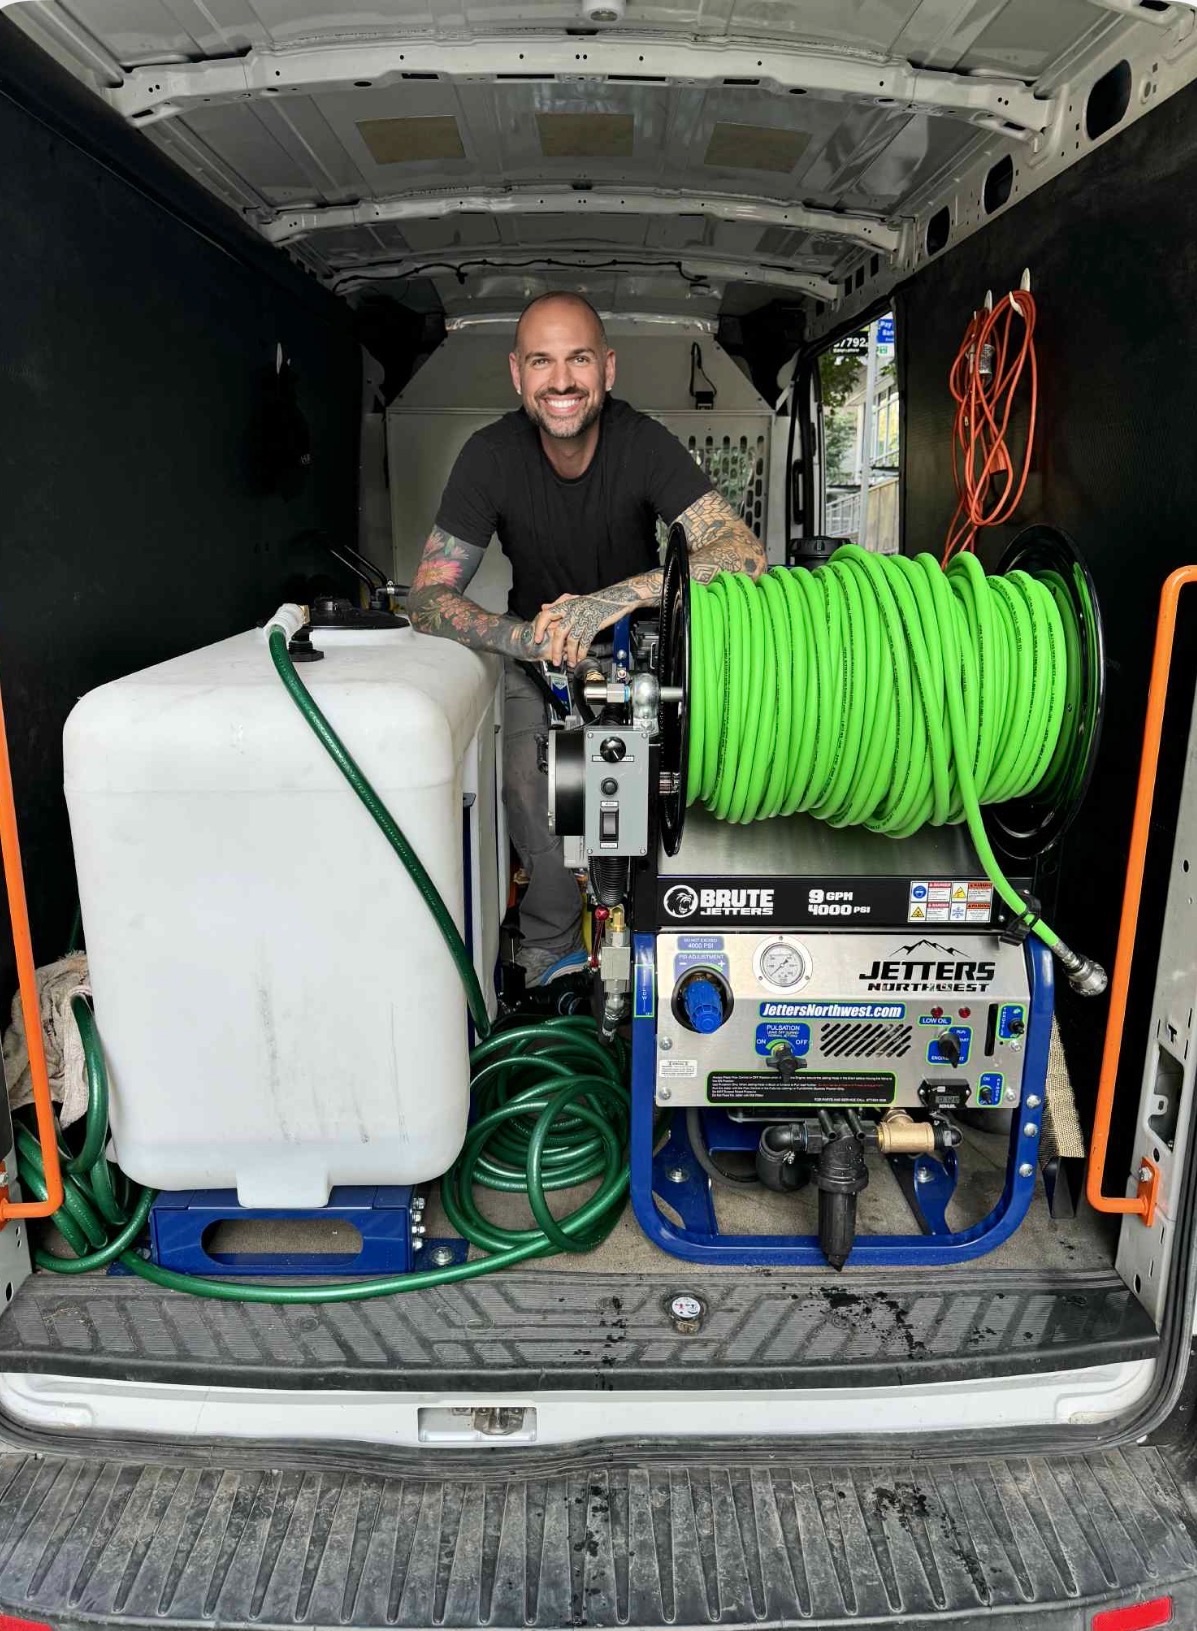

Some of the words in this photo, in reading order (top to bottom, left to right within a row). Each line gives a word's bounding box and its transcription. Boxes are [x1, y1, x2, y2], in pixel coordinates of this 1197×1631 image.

[700, 889, 775, 908] BRUTE
[808, 889, 824, 904] 9
[826, 891, 854, 901] GPM
[700, 907, 774, 916] JETTERS
[808, 904, 852, 915] 4000
[853, 906, 871, 914] PSI
[859, 961, 996, 981] JETTERS
[868, 983, 990, 992] NORTHWEST
[763, 1003, 902, 1018] JettersNorthwest.com
